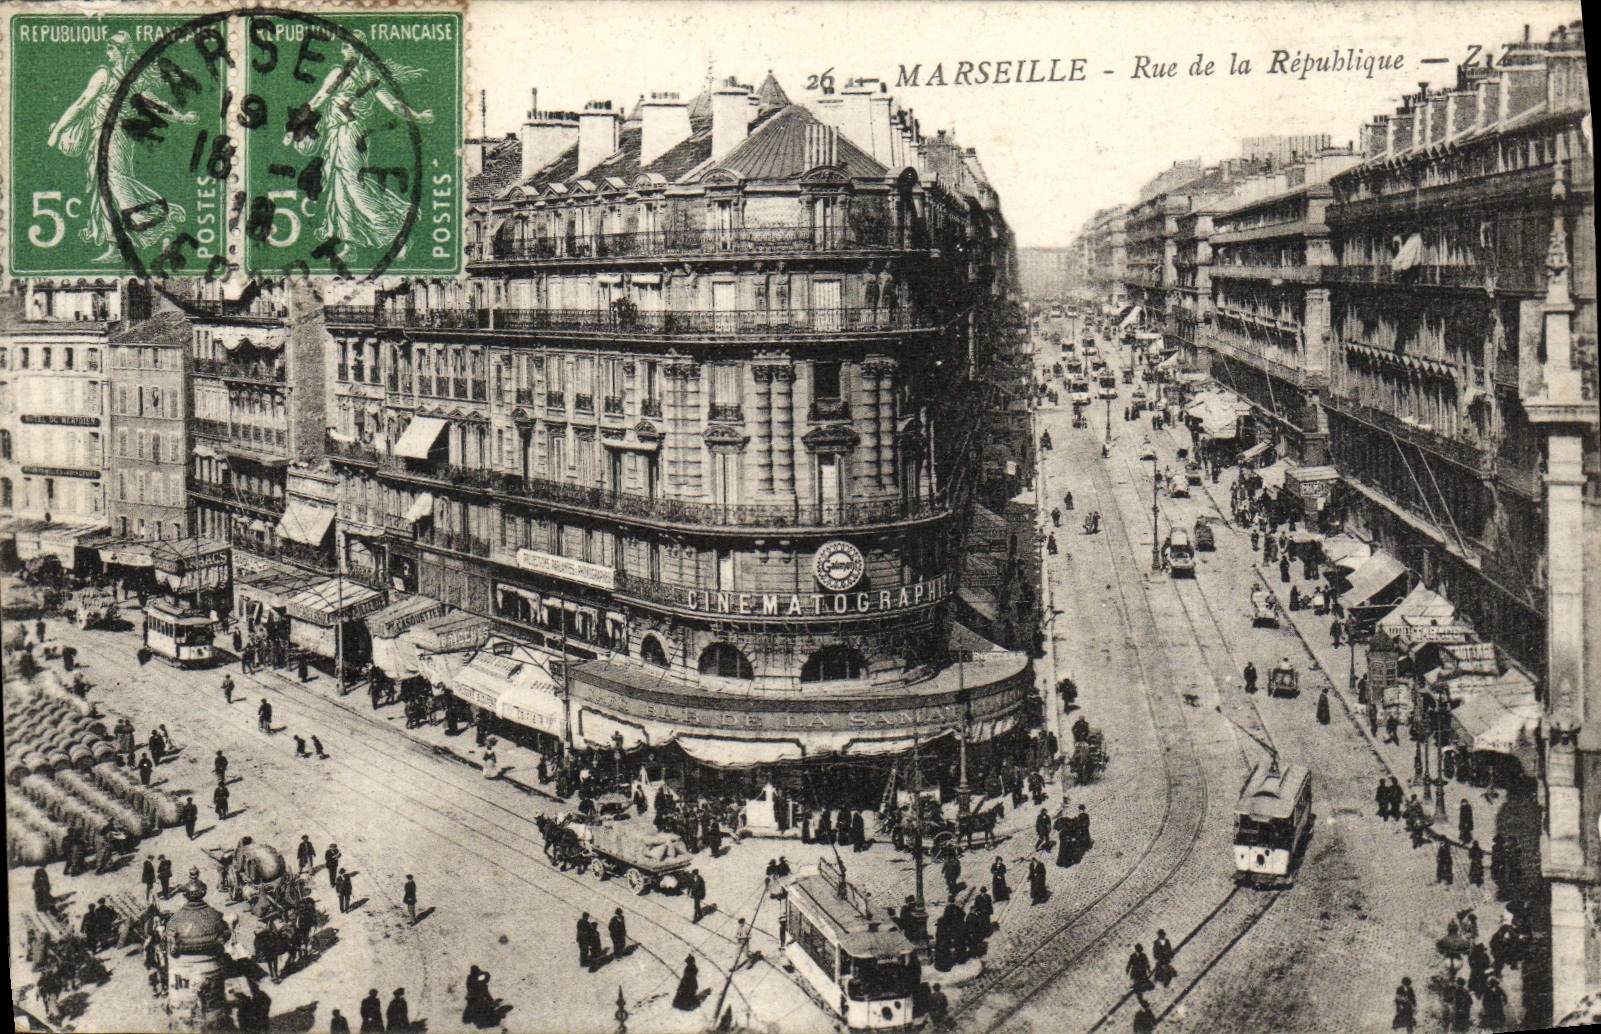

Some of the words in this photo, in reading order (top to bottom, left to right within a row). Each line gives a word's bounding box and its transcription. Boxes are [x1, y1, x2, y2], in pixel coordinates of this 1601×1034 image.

[370, 23, 454, 42] FRANÇAISE
[196, 174, 218, 259] POSTES
[432, 173, 453, 259] POSTES
[646, 703, 701, 724] BAR
[720, 713, 763, 728] DE
[784, 715, 833, 728] LA
